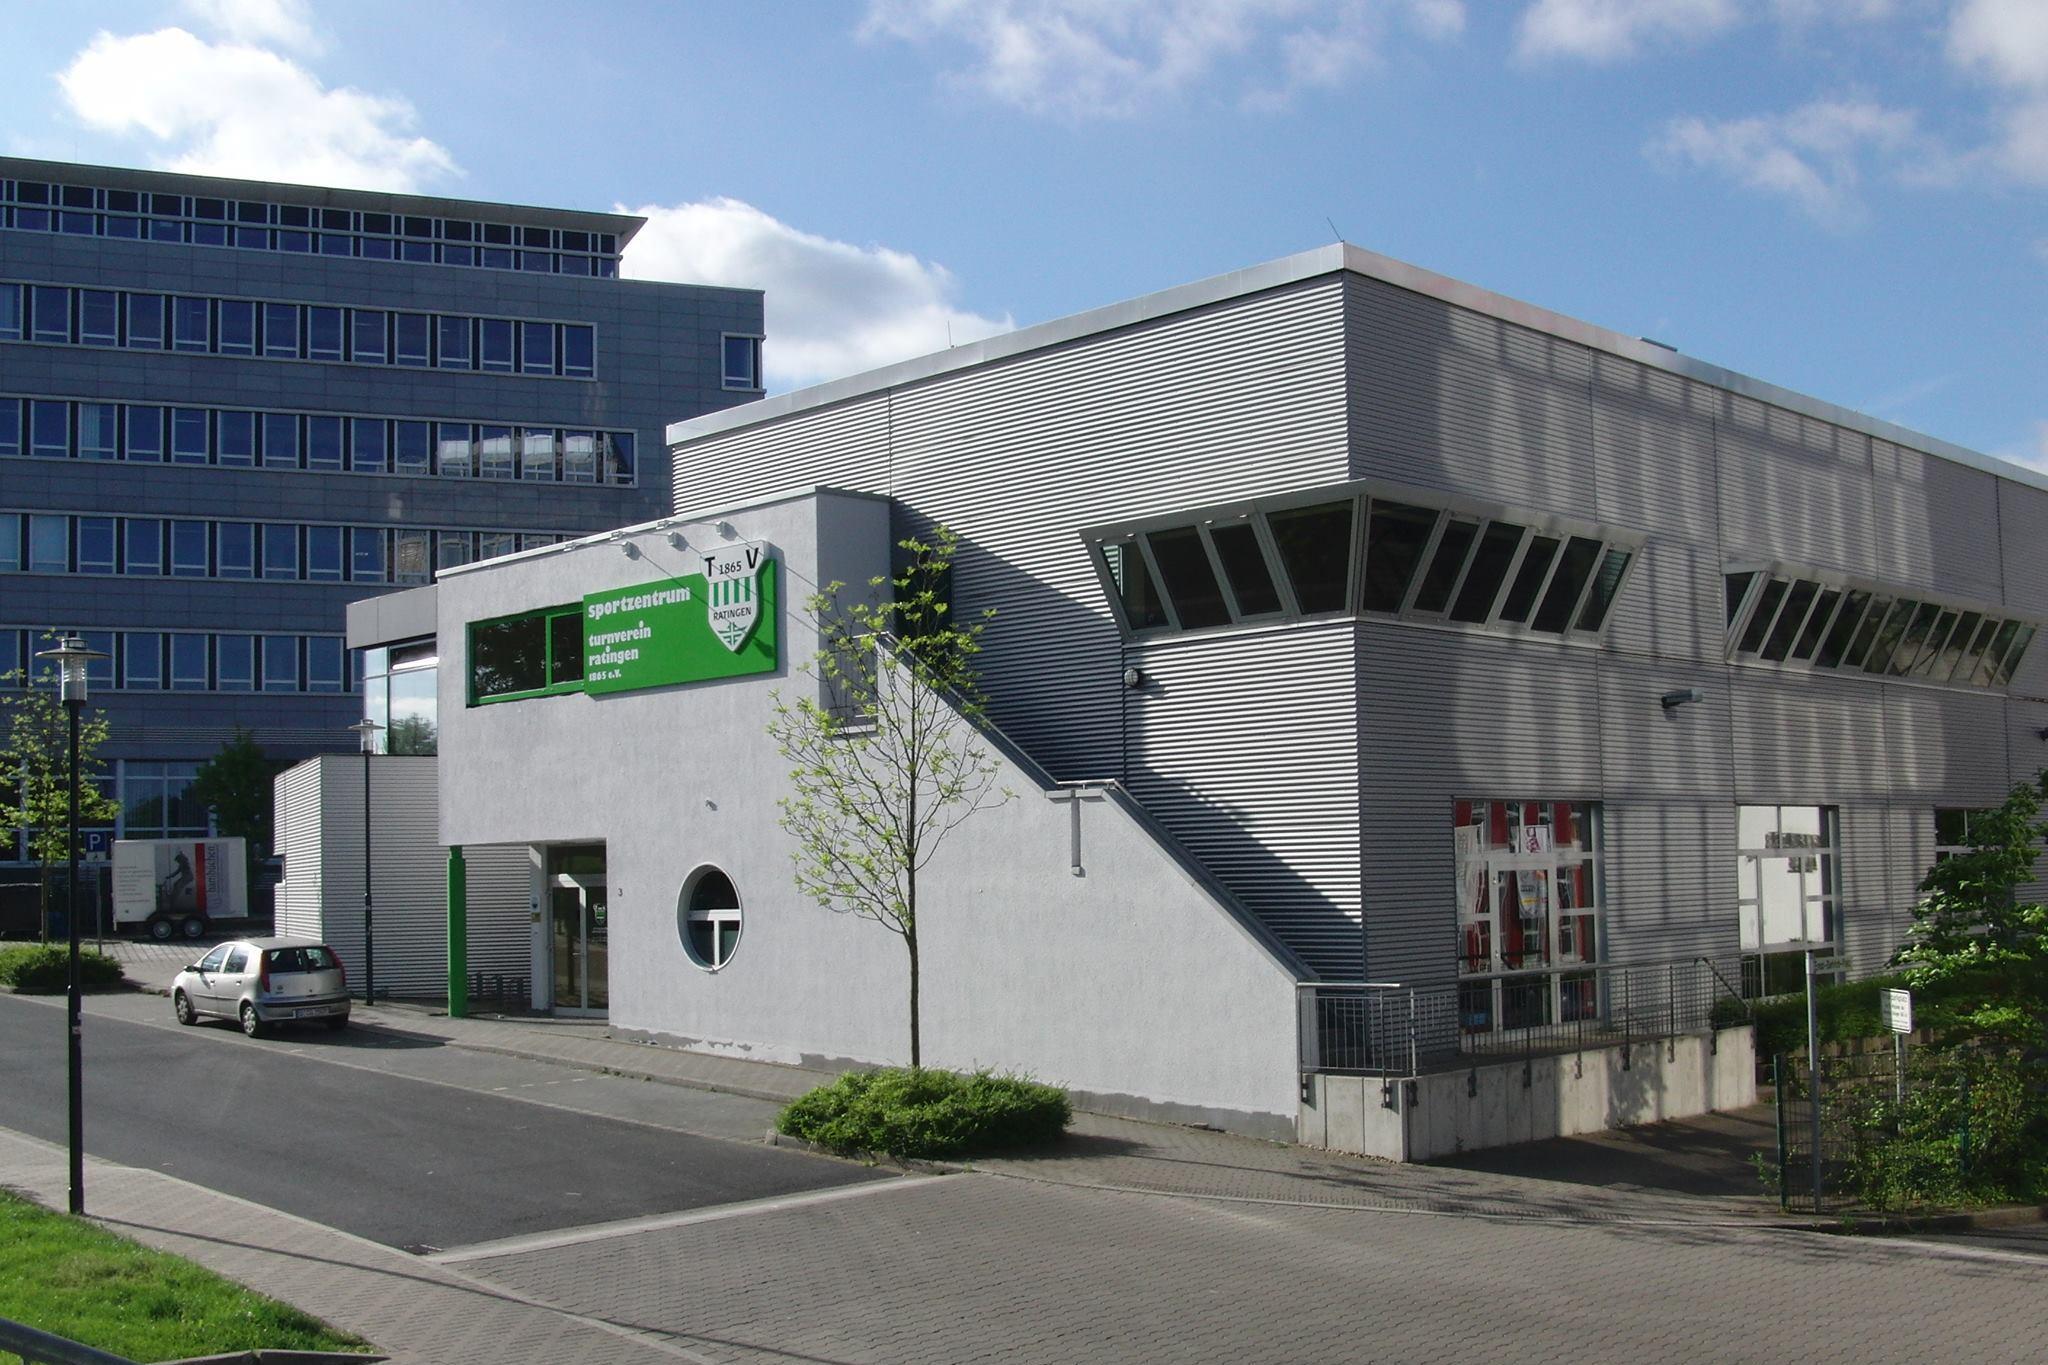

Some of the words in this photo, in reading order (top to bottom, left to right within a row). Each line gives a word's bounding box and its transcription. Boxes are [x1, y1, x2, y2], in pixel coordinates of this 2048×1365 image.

[705, 556, 716, 577] T
[745, 547, 759, 569] V
[720, 561, 742, 575] 1865
[588, 587, 691, 620] sportzentrum
[713, 607, 752, 621] RATINGEN
[589, 620, 651, 647] turnverein
[589, 646, 639, 666] ratingen
[589, 671, 606, 682] 1865
[90, 834, 101, 850] P
[617, 887, 624, 897] 3
